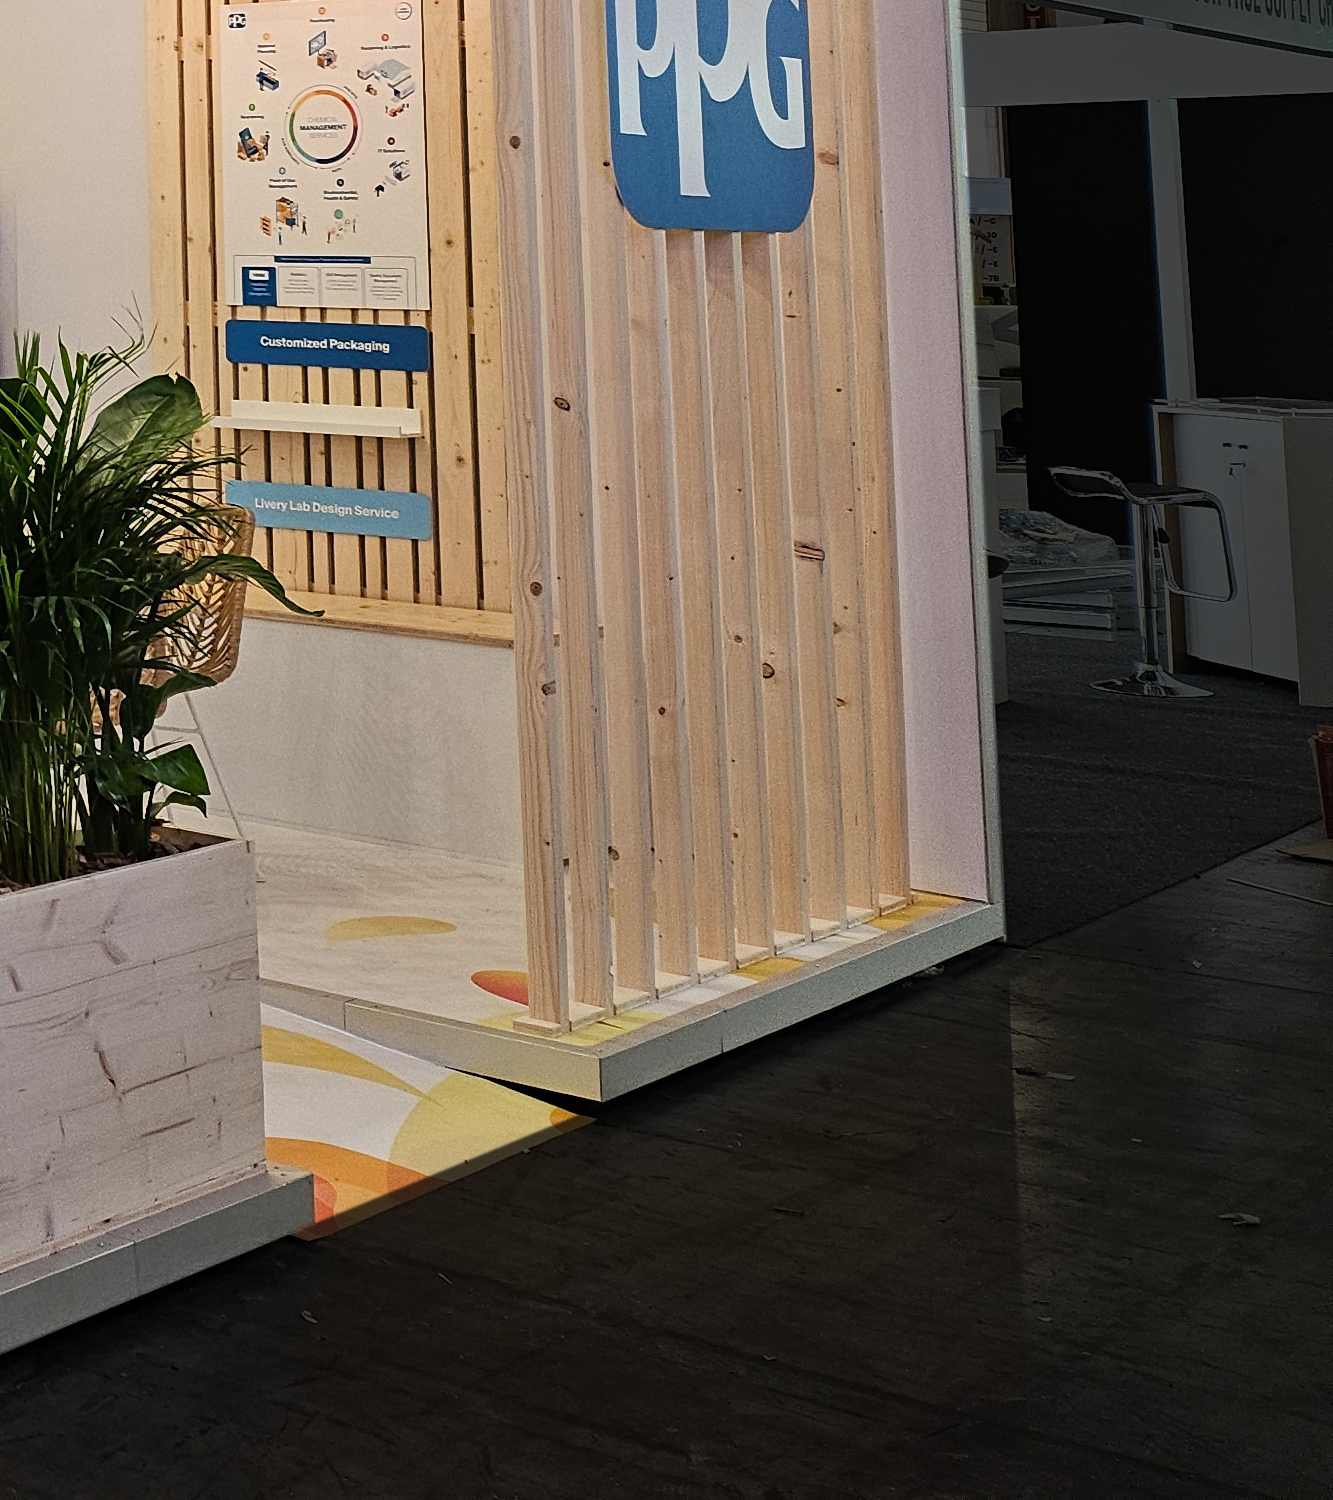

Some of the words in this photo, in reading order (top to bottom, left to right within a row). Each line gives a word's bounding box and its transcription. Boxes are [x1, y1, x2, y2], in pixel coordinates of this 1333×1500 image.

[260, 335, 327, 350] Customized
[329, 338, 390, 354] Packaging
[254, 497, 288, 512] Livery
[289, 500, 310, 512] Lab
[312, 502, 353, 516] Design
[354, 505, 400, 520] Service
